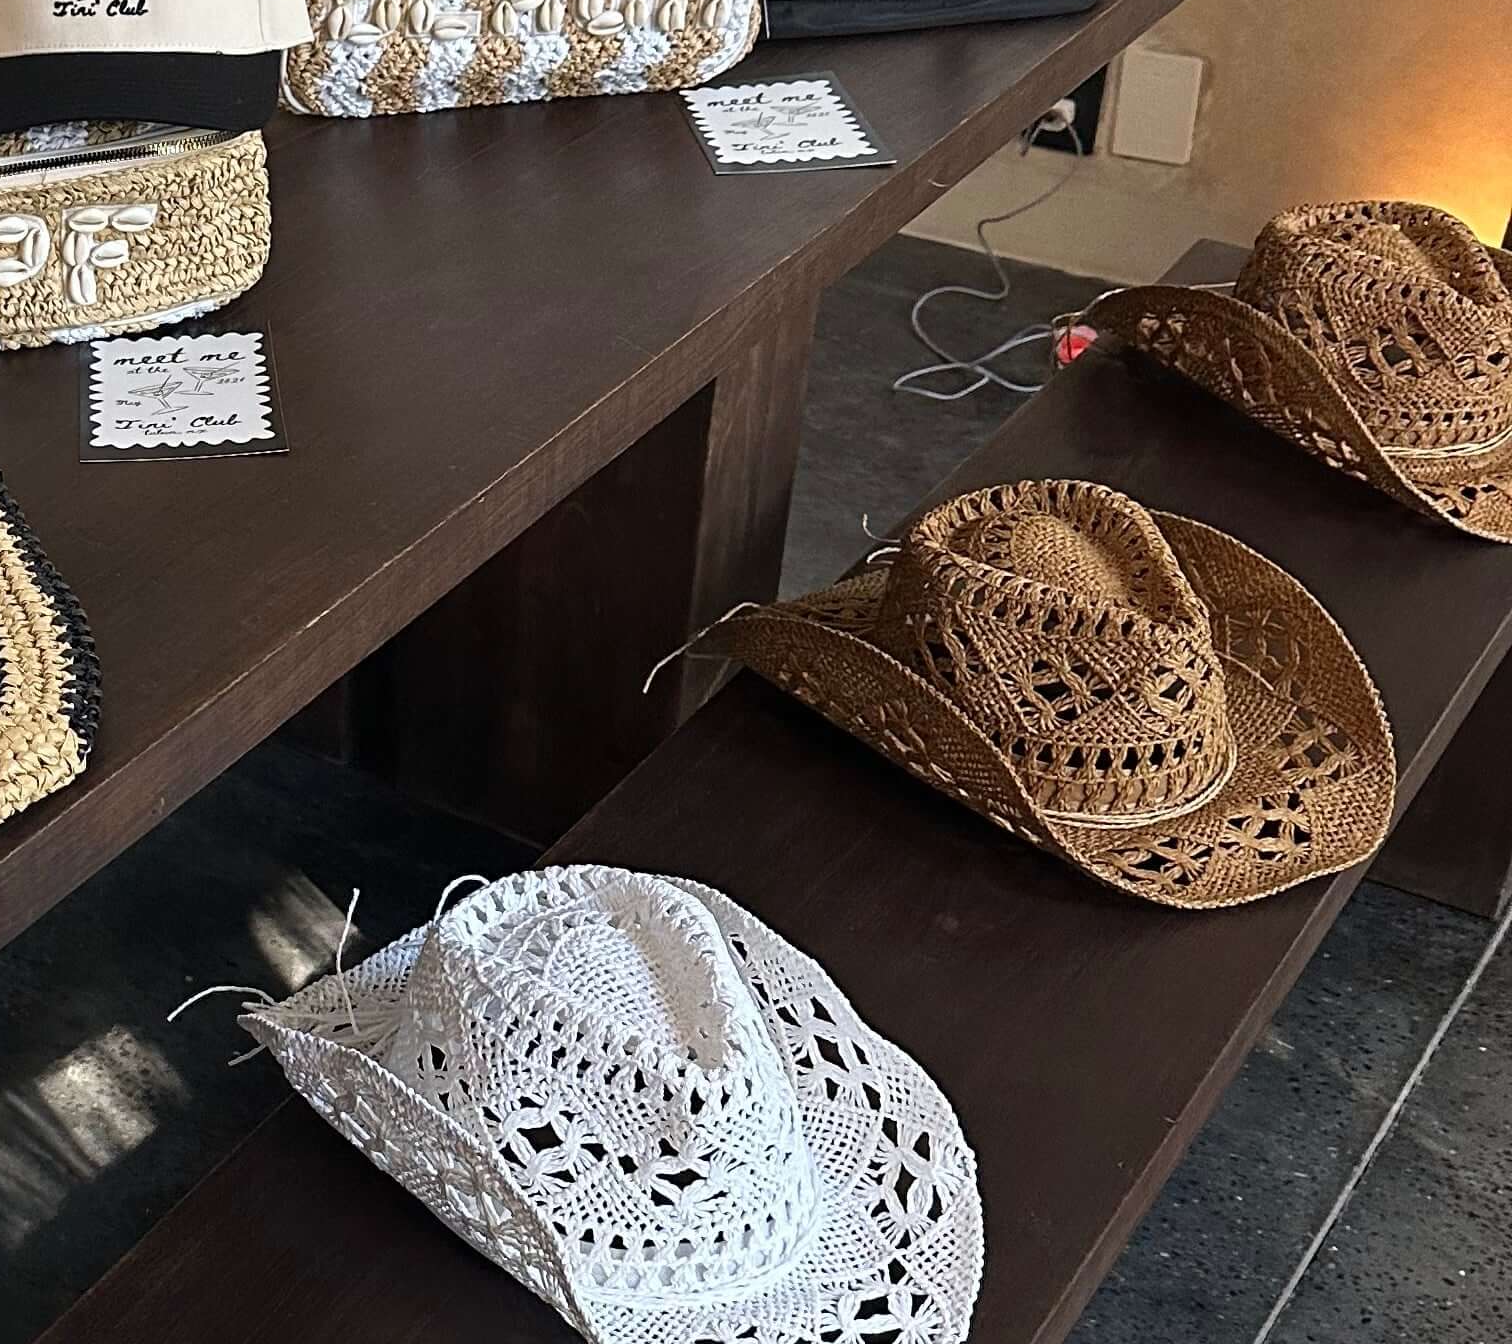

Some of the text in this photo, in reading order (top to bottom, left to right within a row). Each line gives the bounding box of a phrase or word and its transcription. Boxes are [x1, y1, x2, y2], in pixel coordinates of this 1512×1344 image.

[707, 92, 824, 107] meet me
[113, 347, 246, 366] meet me
[190, 413, 242, 428] Club
